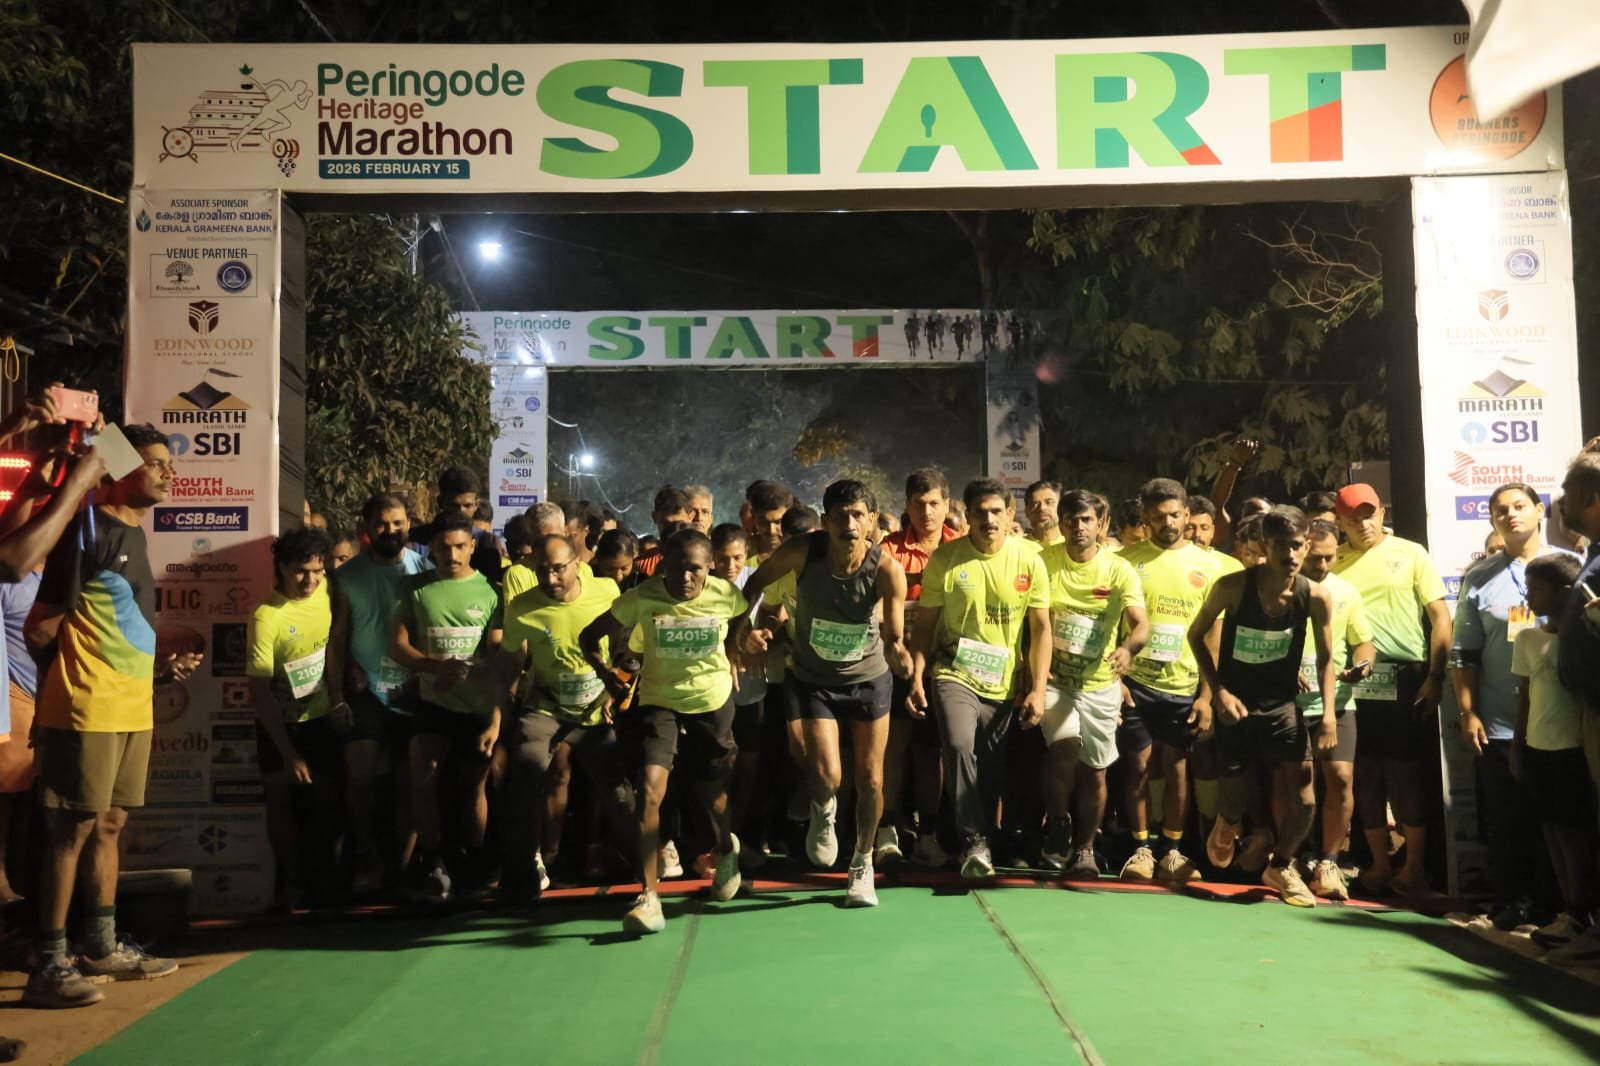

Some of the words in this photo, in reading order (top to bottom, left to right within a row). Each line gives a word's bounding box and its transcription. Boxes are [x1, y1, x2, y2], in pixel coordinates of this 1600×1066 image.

[317, 62, 525, 107] Peringode
[318, 98, 424, 125] Heritage
[535, 44, 1386, 179] START
[318, 121, 512, 155] Marathon
[327, 163, 360, 174] 2026
[365, 163, 441, 174] FEBRUARY
[446, 163, 460, 174] 15
[170, 199, 210, 208] ASSOCIATE
[212, 199, 249, 208] SPONSOR
[1531, 210, 1557, 219] BANK
[166, 248, 200, 259] VENUE
[202, 248, 248, 259] PARTNER
[494, 316, 571, 333] Peringode
[587, 315, 894, 360] START
[154, 338, 254, 350] EDINWOOD
[1458, 398, 1543, 413] MARATH
[163, 411, 246, 424] MARATH
[1491, 420, 1539, 443] SBI
[194, 432, 240, 455] SBI
[1012, 461, 1026, 471] SBI
[1472, 465, 1523, 475] SOUTH
[515, 468, 531, 478] SBI
[1472, 474, 1523, 484] INDIAN
[1527, 474, 1556, 483] Bank
[171, 477, 222, 487] SOUTH
[171, 487, 222, 496] INDIAN
[226, 487, 255, 496] Bank
[175, 512, 204, 525] CSB
[205, 512, 241, 525] Bank
[167, 589, 201, 609] LIC
[666, 630, 709, 642] 24015
[1151, 634, 1175, 646] 069
[436, 639, 473, 649] 21063
[963, 650, 999, 668] 22032
